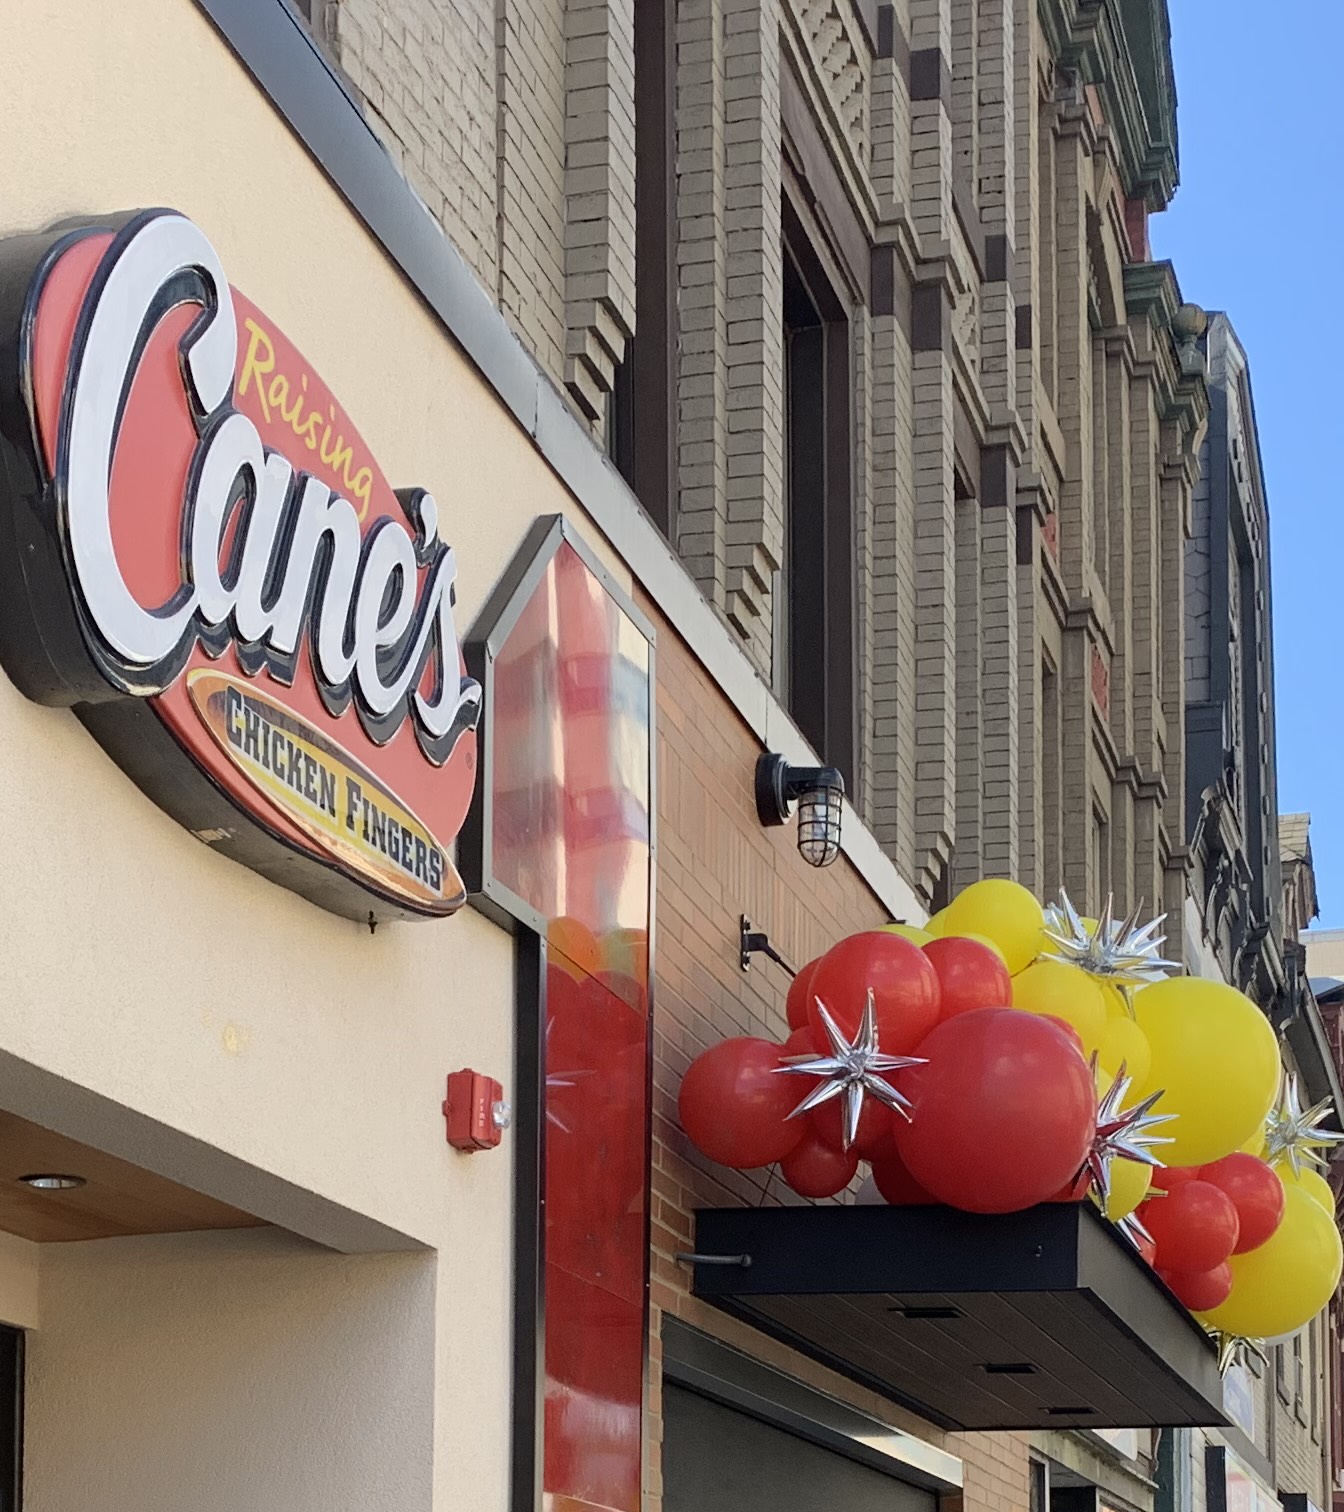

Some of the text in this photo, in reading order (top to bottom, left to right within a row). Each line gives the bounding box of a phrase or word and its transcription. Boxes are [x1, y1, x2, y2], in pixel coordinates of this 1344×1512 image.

[66, 211, 483, 738] Cane's
[238, 317, 375, 523] Raising
[224, 684, 444, 894] CHICKEN FINGERS
